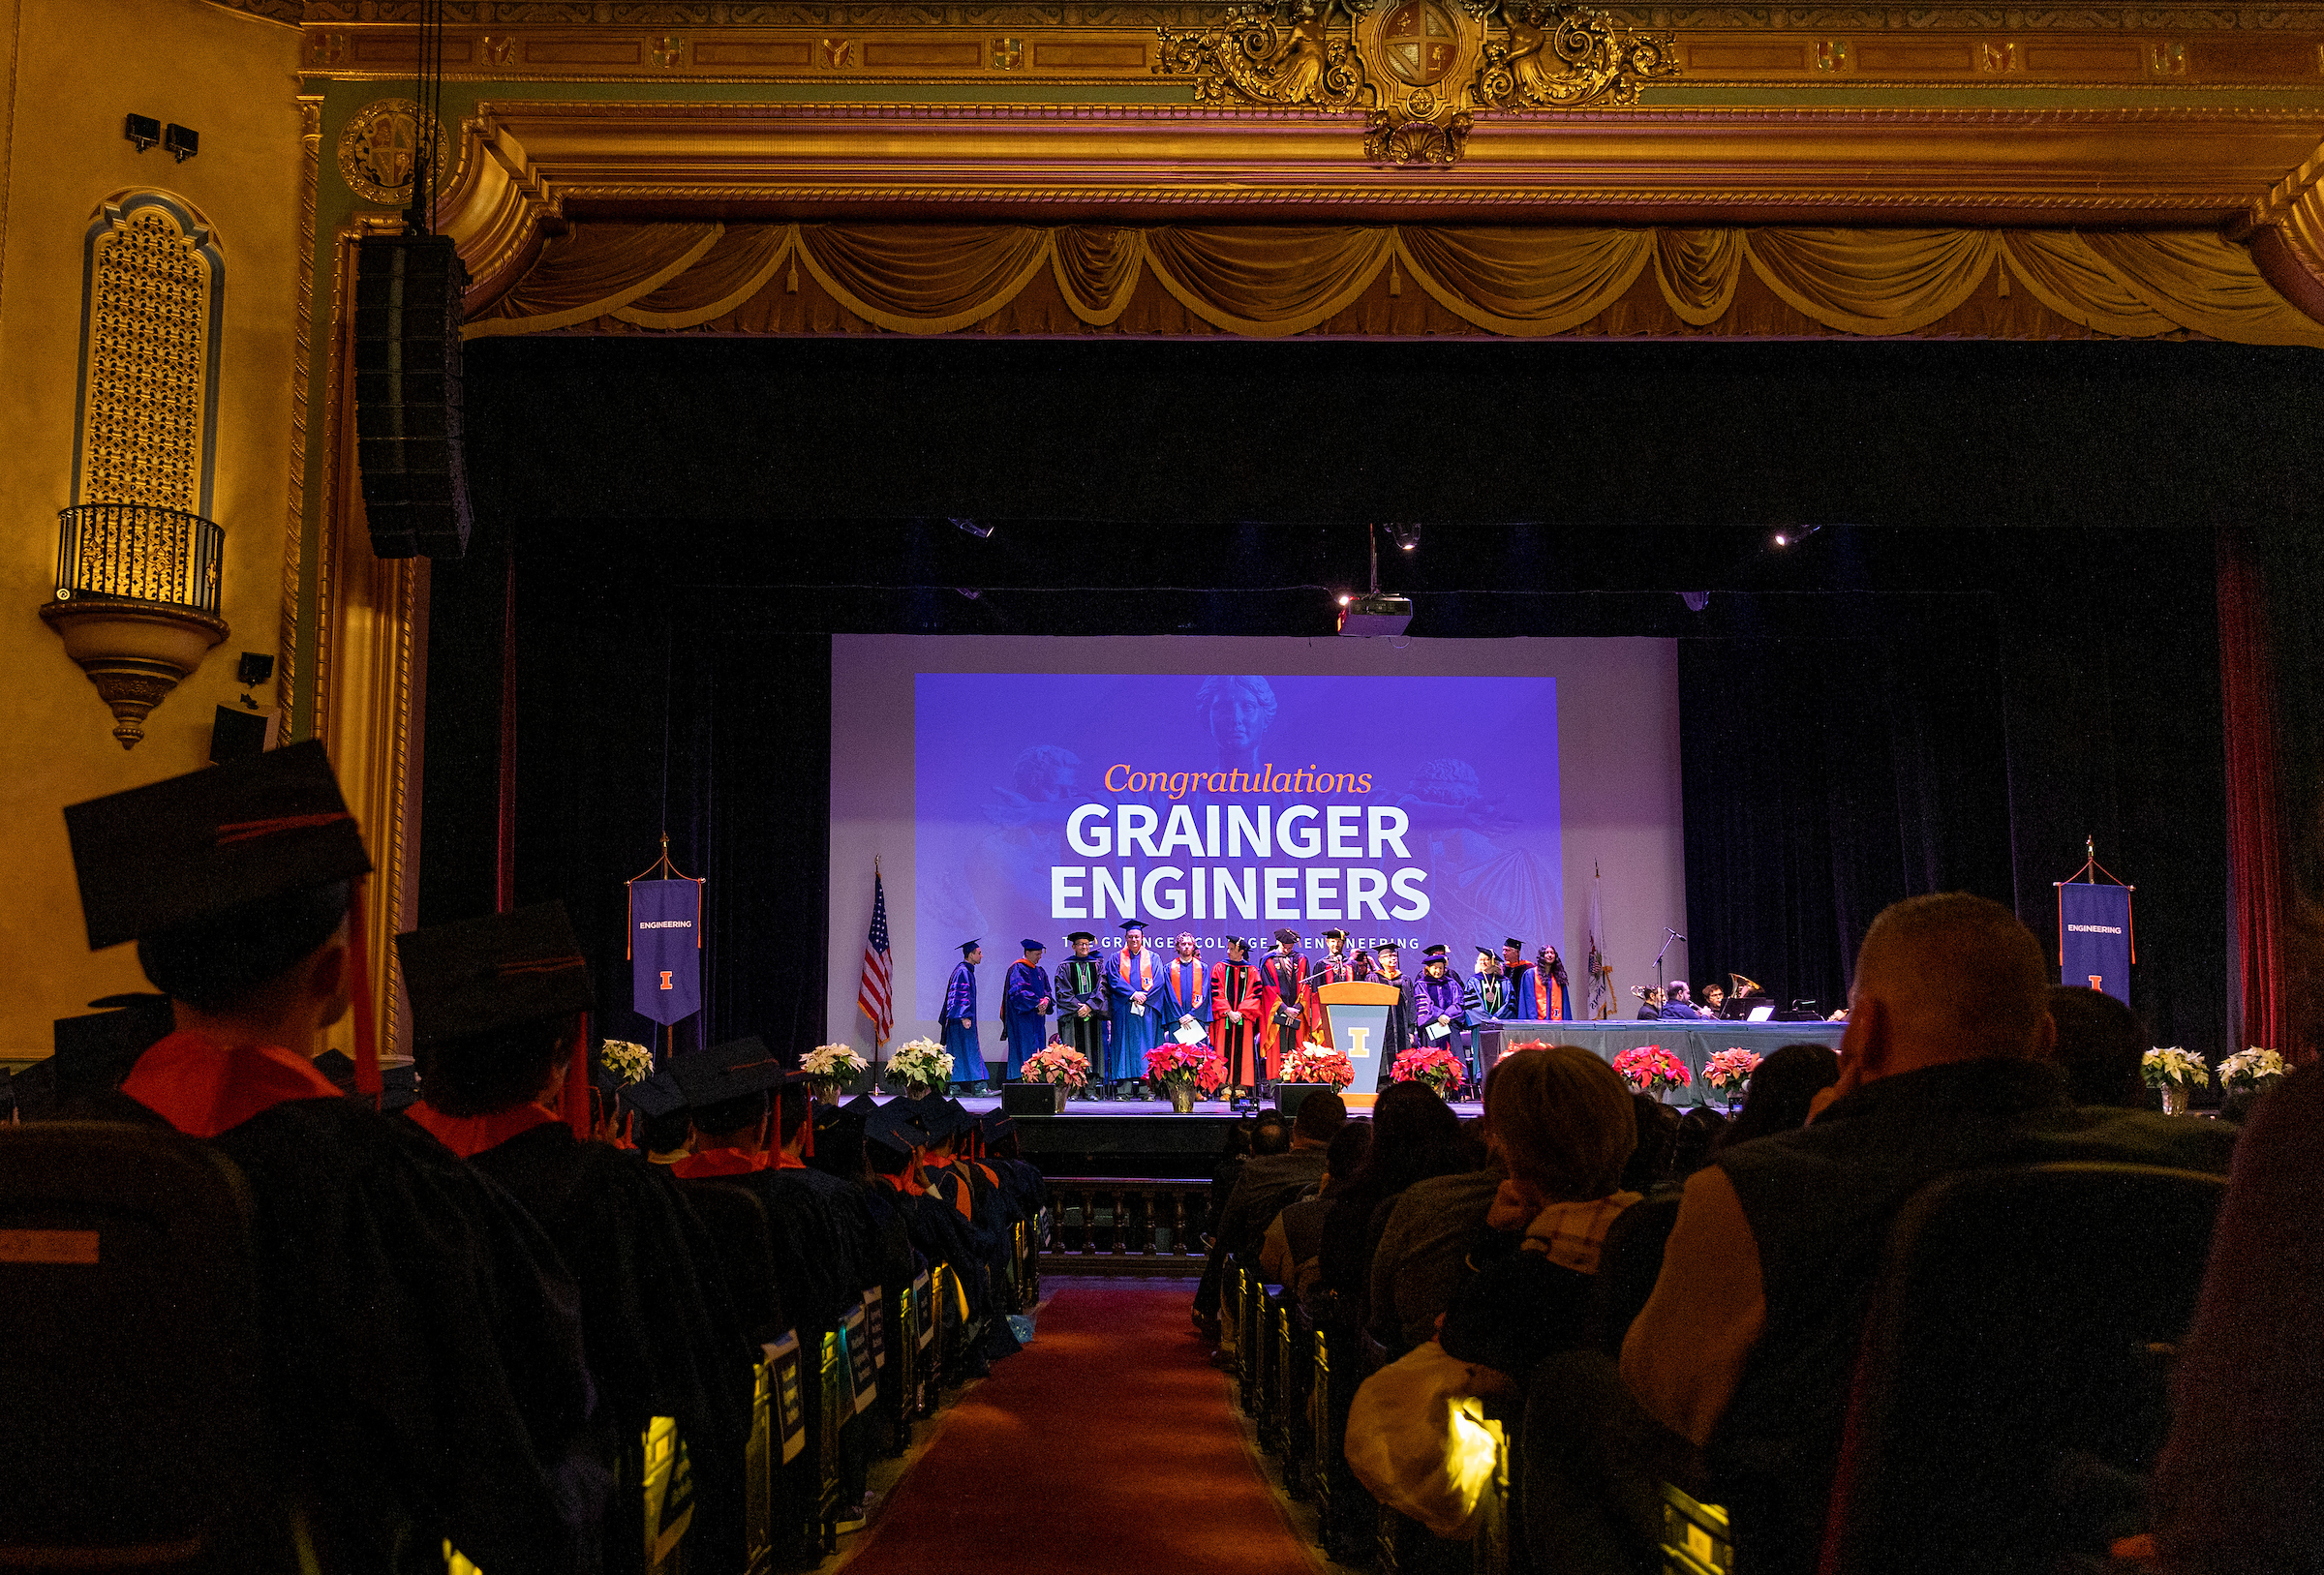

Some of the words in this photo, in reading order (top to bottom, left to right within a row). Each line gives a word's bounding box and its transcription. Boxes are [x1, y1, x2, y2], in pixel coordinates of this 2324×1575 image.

[1105, 764, 1372, 799] Congratulations
[1066, 803, 1412, 859] GRAINGER
[1051, 866, 1430, 921] ENGINEERS
[639, 921, 692, 929] ENGINEERING
[2067, 924, 2122, 934] ENGINEERING
[1101, 937, 1175, 949] GRNGE
[1194, 937, 1269, 949] COLGE
[660, 971, 673, 989] I
[1348, 1027, 1369, 1058] I
